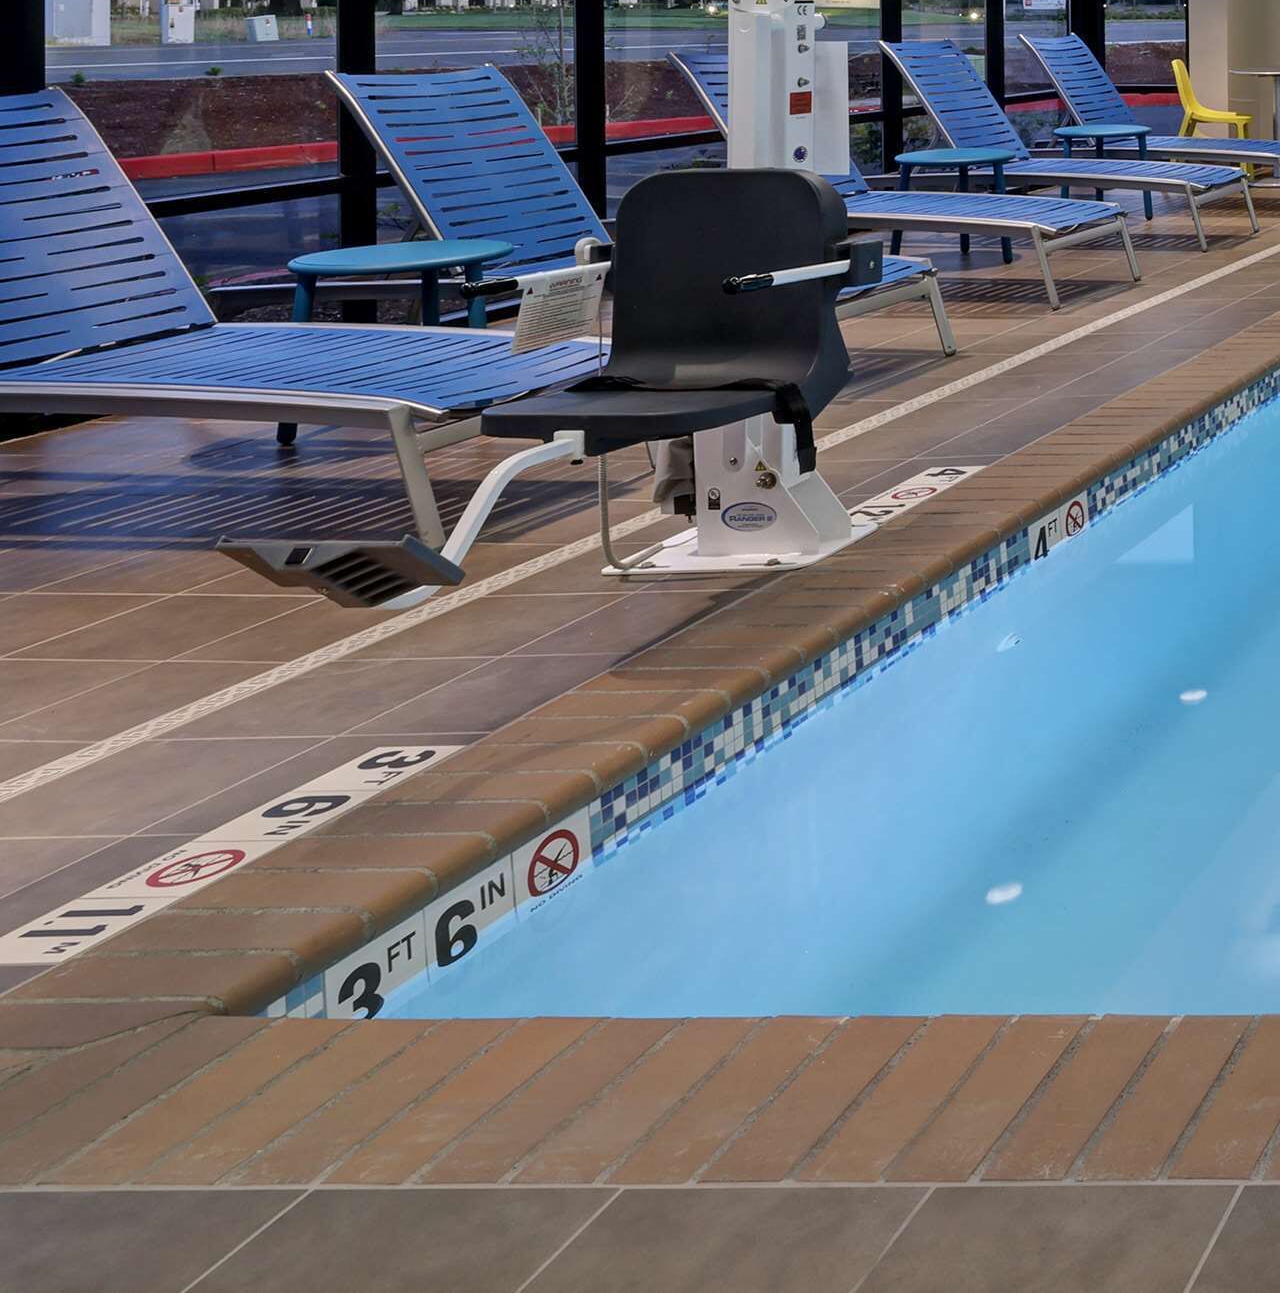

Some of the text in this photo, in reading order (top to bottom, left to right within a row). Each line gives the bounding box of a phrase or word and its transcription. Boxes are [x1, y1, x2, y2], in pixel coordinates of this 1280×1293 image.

[925, 468, 967, 477] 4
[1034, 518, 1058, 560] 4 FT
[357, 748, 438, 770] 3
[363, 770, 404, 786] FT
[261, 794, 352, 818] 6
[263, 820, 312, 836] IN
[530, 900, 546, 913] NO
[338, 873, 506, 1019] 3 FT 6 IN
